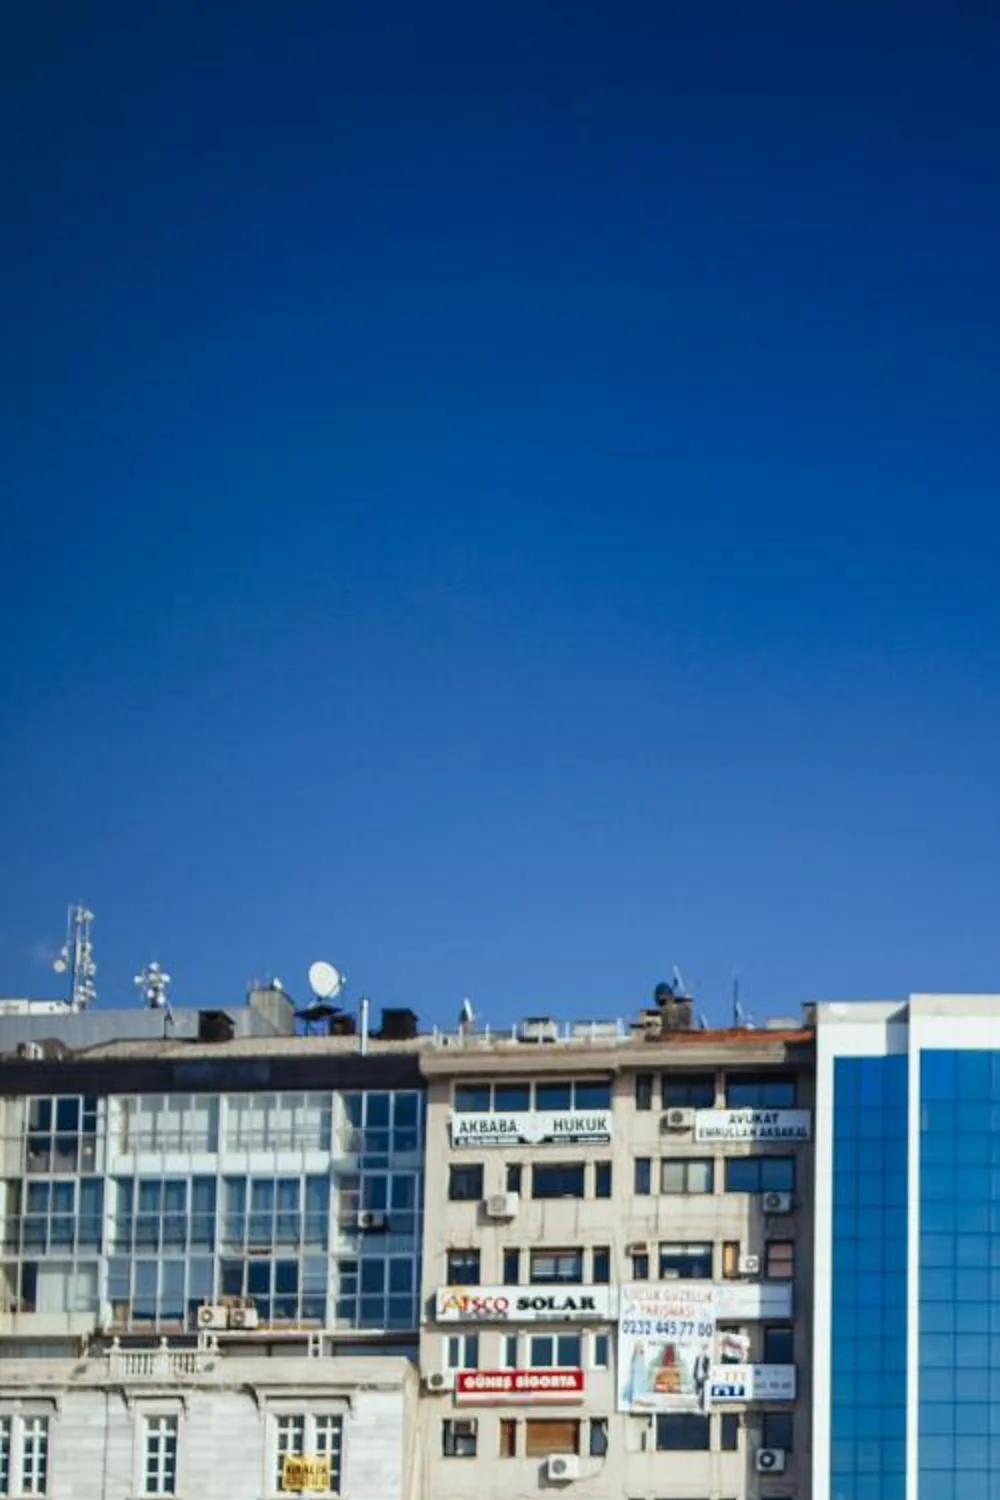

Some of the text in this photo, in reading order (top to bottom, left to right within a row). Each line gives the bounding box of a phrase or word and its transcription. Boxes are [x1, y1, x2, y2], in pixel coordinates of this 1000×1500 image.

[459, 1117, 607, 1134] AKBABA HUKUK
[728, 1112, 779, 1124] AVUKAT
[516, 1295, 596, 1311] SOLAR
[463, 1374, 512, 1389] GÜNEŞ
